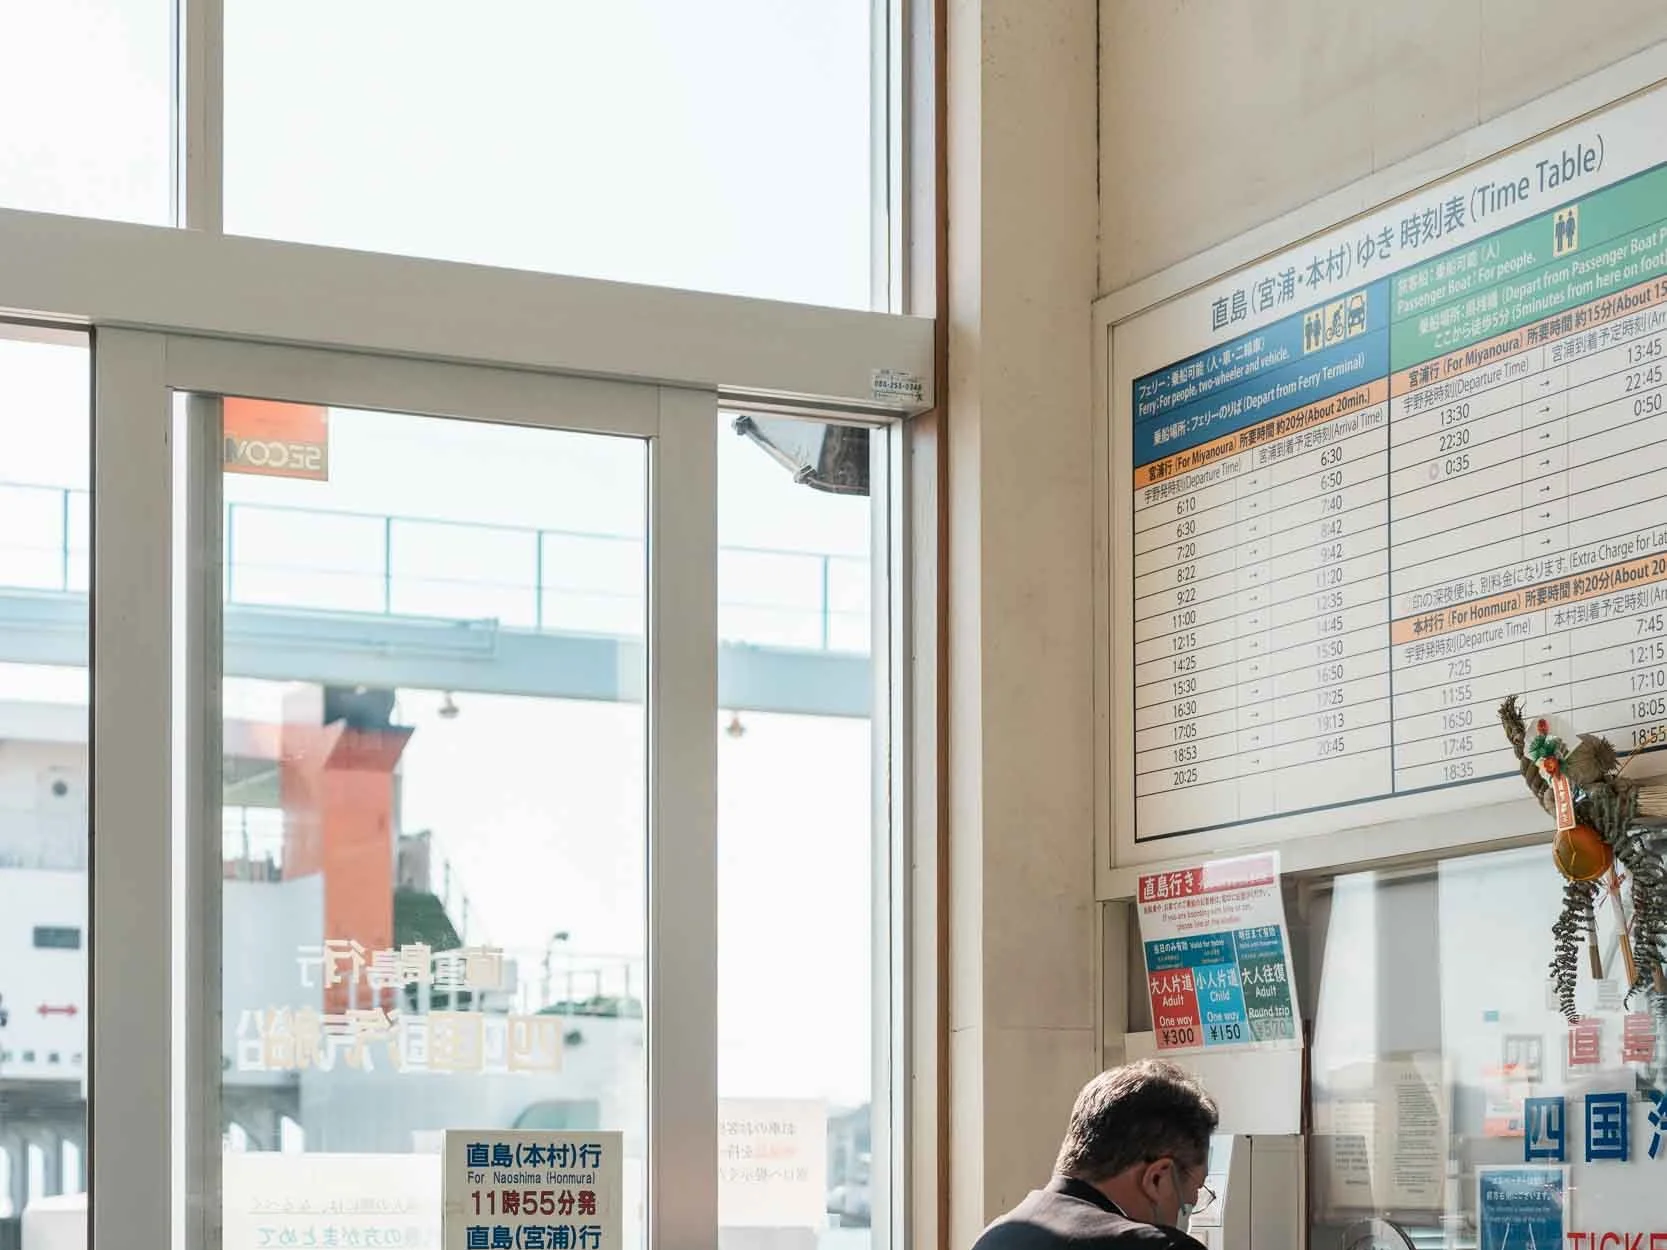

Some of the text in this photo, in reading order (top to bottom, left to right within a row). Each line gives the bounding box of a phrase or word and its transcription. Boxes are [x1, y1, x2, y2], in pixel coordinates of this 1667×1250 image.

[1536, 134, 1604, 193] Table)
[1543, 265, 1569, 288] from
[1572, 246, 1627, 275] Passenger
[1631, 230, 1658, 253] Boat
[1567, 281, 1592, 302] from
[1595, 268, 1621, 290] here
[1623, 262, 1638, 277] on
[1276, 381, 1297, 402] from
[1298, 370, 1320, 394] Ferry
[1323, 353, 1365, 378] Terminal)
[1409, 366, 1439, 388] 宮浦行
[1440, 339, 1662, 425] 13:30 13:45
[1440, 365, 1663, 451] 22:30 22:45
[1445, 393, 1662, 475] 0:35 0:50
[1177, 447, 1342, 515] 6:10 6:30
[1177, 470, 1342, 538] 6:30 6:50
[1177, 543, 1195, 560] 7:20
[1177, 520, 1342, 583] 8:22 8:42
[1599, 541, 1634, 560] Charge
[1636, 534, 1651, 552] for
[1177, 588, 1196, 605] 9:22
[1413, 614, 1444, 636] 本村行
[1470, 596, 1521, 620] Honmura)
[1651, 558, 1666, 577] 20
[1173, 611, 1196, 630] 11:00
[1173, 633, 1196, 651] 12:15
[1448, 614, 1664, 679] 7:25 7:45
[1173, 656, 1196, 674] 14:25
[1442, 641, 1664, 706] 11:55 12:15
[1173, 678, 1196, 697] 15:30
[1174, 700, 1196, 719] 16:30
[1442, 669, 1665, 730] 16:50 17:10
[1174, 723, 1197, 741] 17:05
[1443, 697, 1666, 756] 17:45 18:05
[1174, 745, 1197, 763] 18:53
[1443, 725, 1666, 781] 18:35 18:55
[1174, 768, 1197, 786] 20:25
[1143, 872, 1194, 900] 直島行き
[1151, 974, 1193, 995] 大人片道
[1196, 967, 1239, 990] 小人片道
[1241, 963, 1286, 985] 大人往復
[1162, 996, 1184, 1007] Adult
[1210, 990, 1230, 1002] Child
[1255, 985, 1277, 998] Adult
[1159, 1016, 1193, 1028] One way
[1207, 1011, 1239, 1023] One way
[1248, 1007, 1273, 1018] Round
[1162, 1028, 1194, 1045] ¥300
[1210, 1024, 1241, 1041] ¥150
[466, 1143, 601, 1168] 直島(本村)行
[468, 1171, 595, 1185] For Naoshima (Honmura)
[472, 1190, 596, 1215] 11時55分発
[466, 1225, 601, 1250] 直島(宮浦)行
